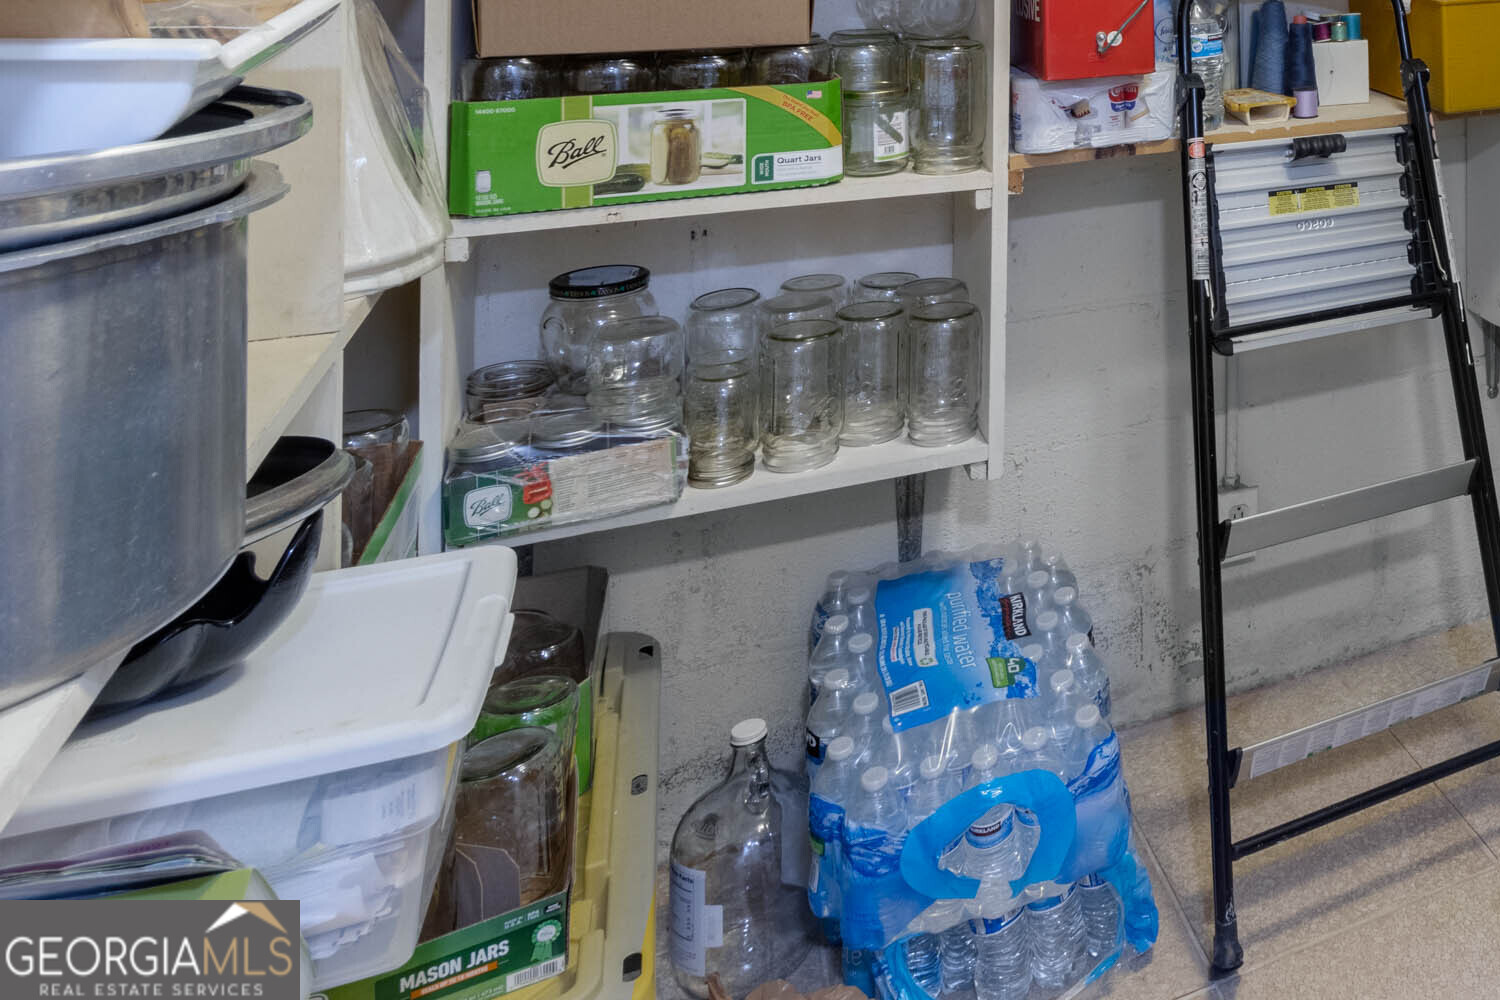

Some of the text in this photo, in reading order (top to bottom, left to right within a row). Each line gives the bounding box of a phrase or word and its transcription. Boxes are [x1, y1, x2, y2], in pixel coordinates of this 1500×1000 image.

[548, 135, 607, 170] Ball
[776, 154, 823, 165] Quart Jars
[470, 491, 506, 519] Ball
[945, 591, 977, 669] purified water
[1010, 593, 1027, 637] KIRKLAND
[1007, 657, 1020, 674] 40
[400, 956, 462, 993] MASON
[466, 939, 510, 969] JARS
